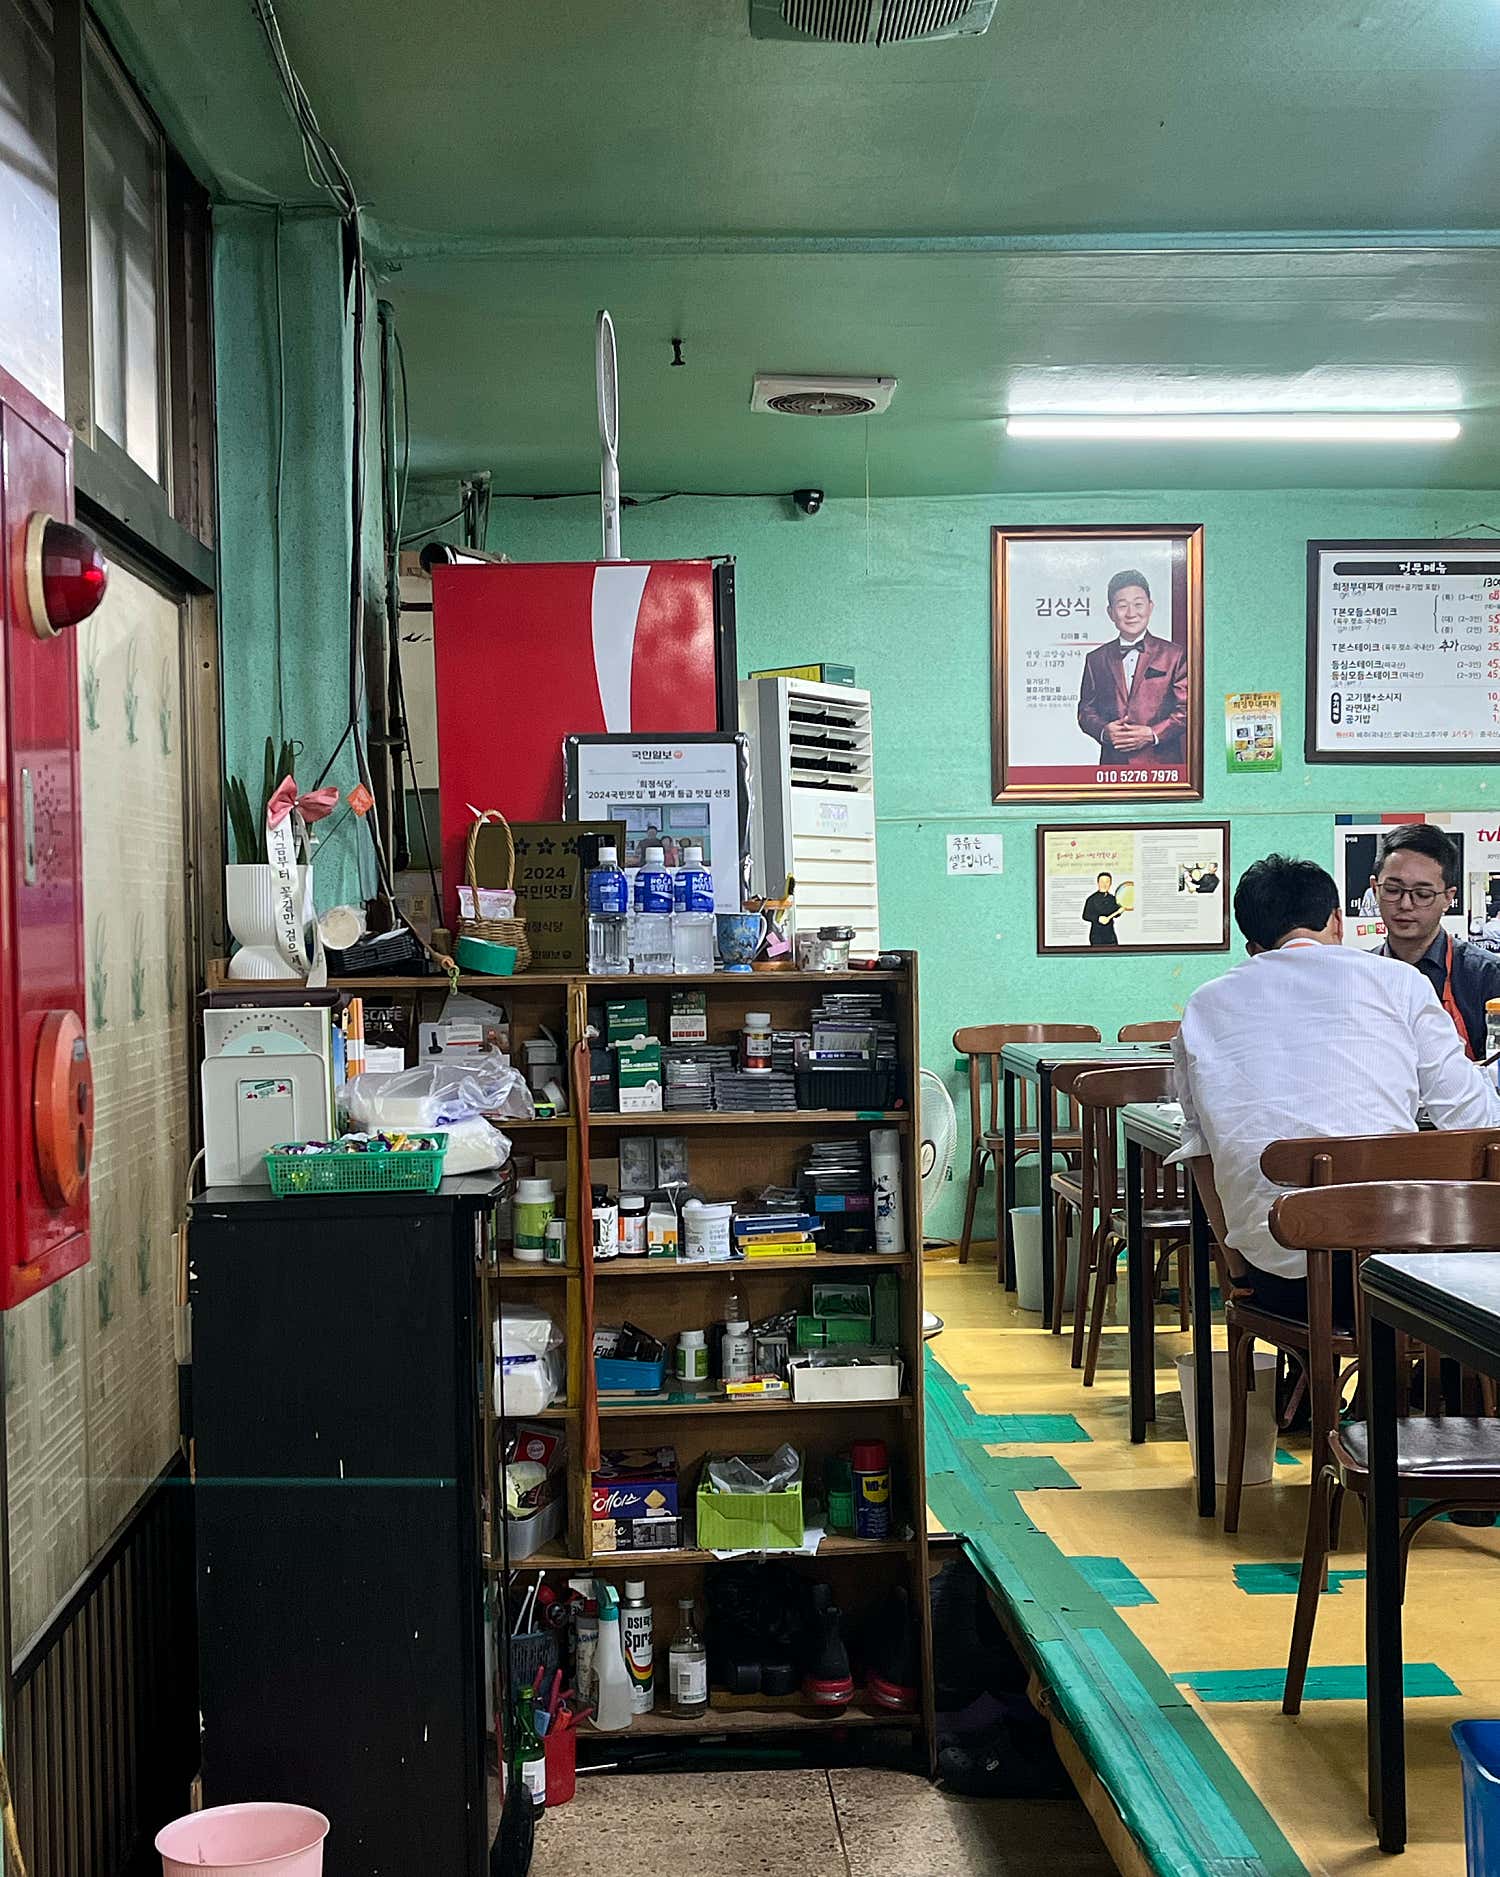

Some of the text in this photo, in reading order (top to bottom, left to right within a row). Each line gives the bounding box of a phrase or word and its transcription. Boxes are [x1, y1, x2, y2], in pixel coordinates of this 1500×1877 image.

[1035, 597, 1090, 617] 김상식
[1345, 704, 1380, 713] 라면사리
[1346, 714, 1371, 724] 공기밥
[632, 751, 672, 760] 국민일보
[1096, 770, 1179, 783] 010 5276 7978
[273, 829, 290, 880] 지금부터
[524, 867, 566, 880] 2024
[517, 885, 573, 900] 국민맛집
